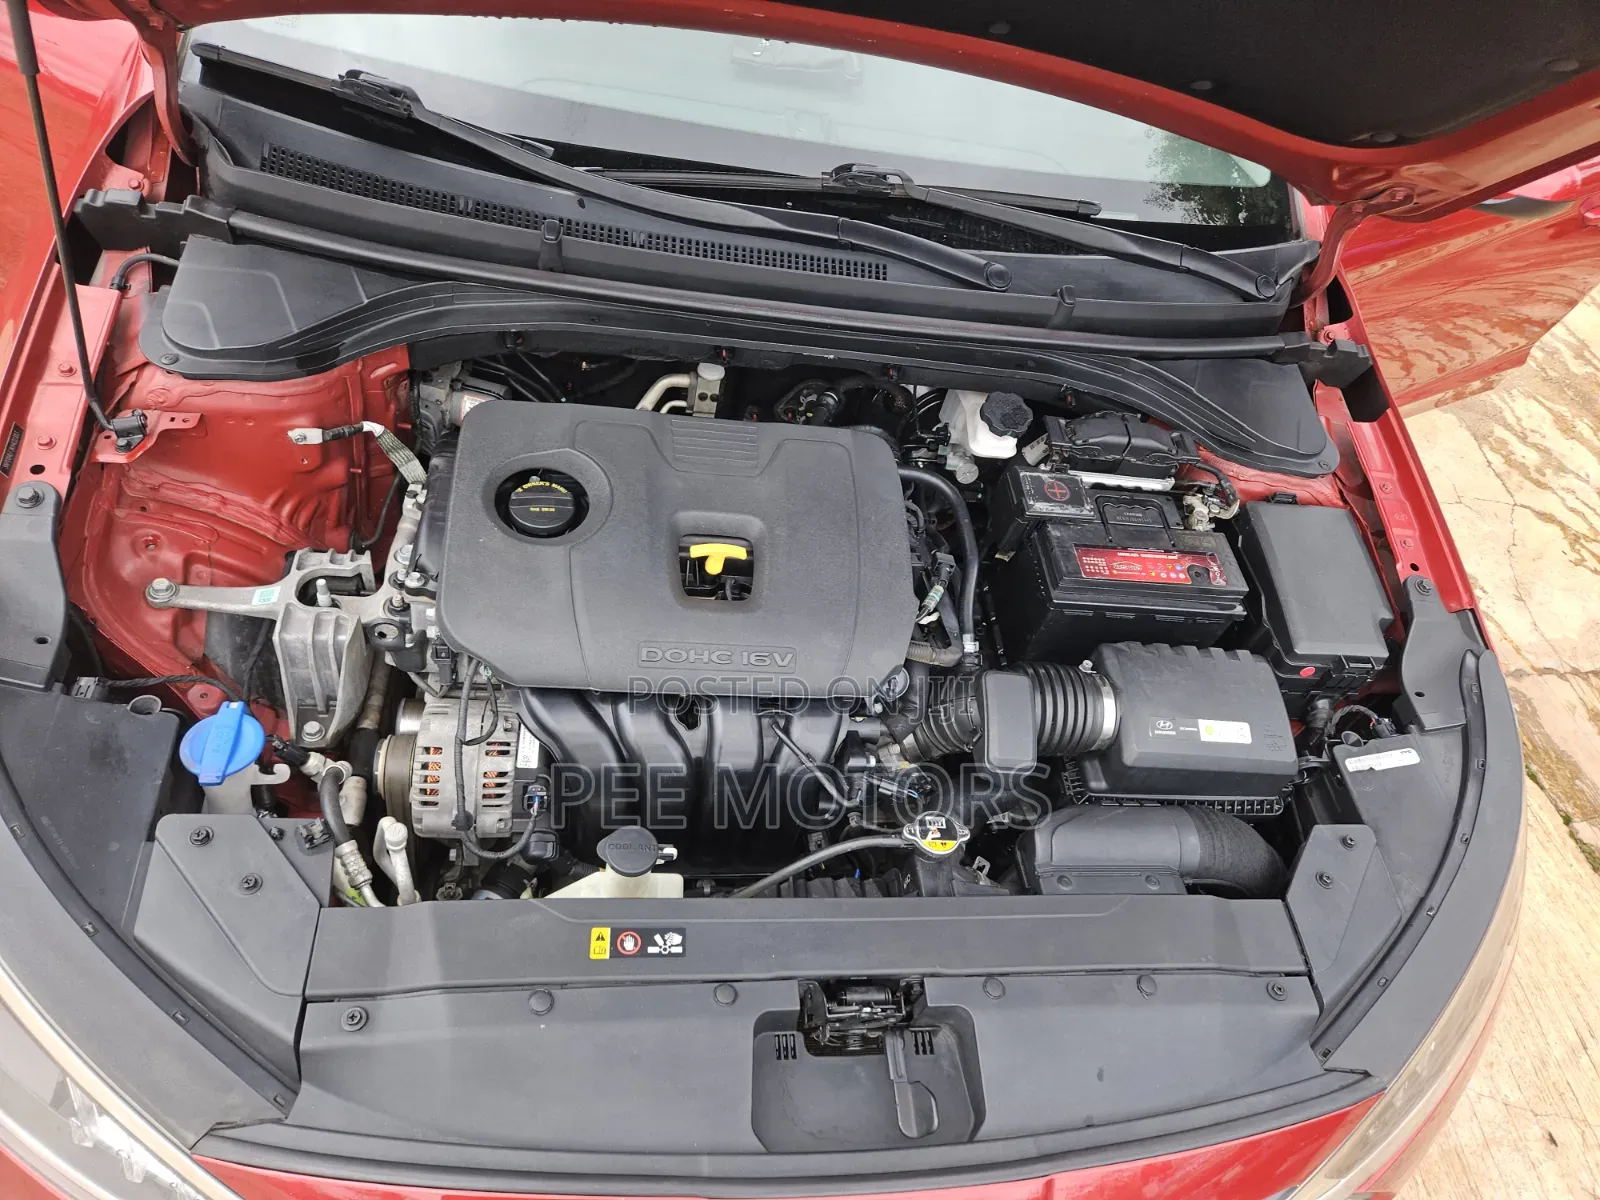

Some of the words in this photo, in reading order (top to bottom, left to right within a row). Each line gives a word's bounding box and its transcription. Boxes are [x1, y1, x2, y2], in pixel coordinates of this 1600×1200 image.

[641, 647, 732, 665] DOHC
[742, 651, 794, 667] 16V
[608, 842, 658, 853] COOLANT
